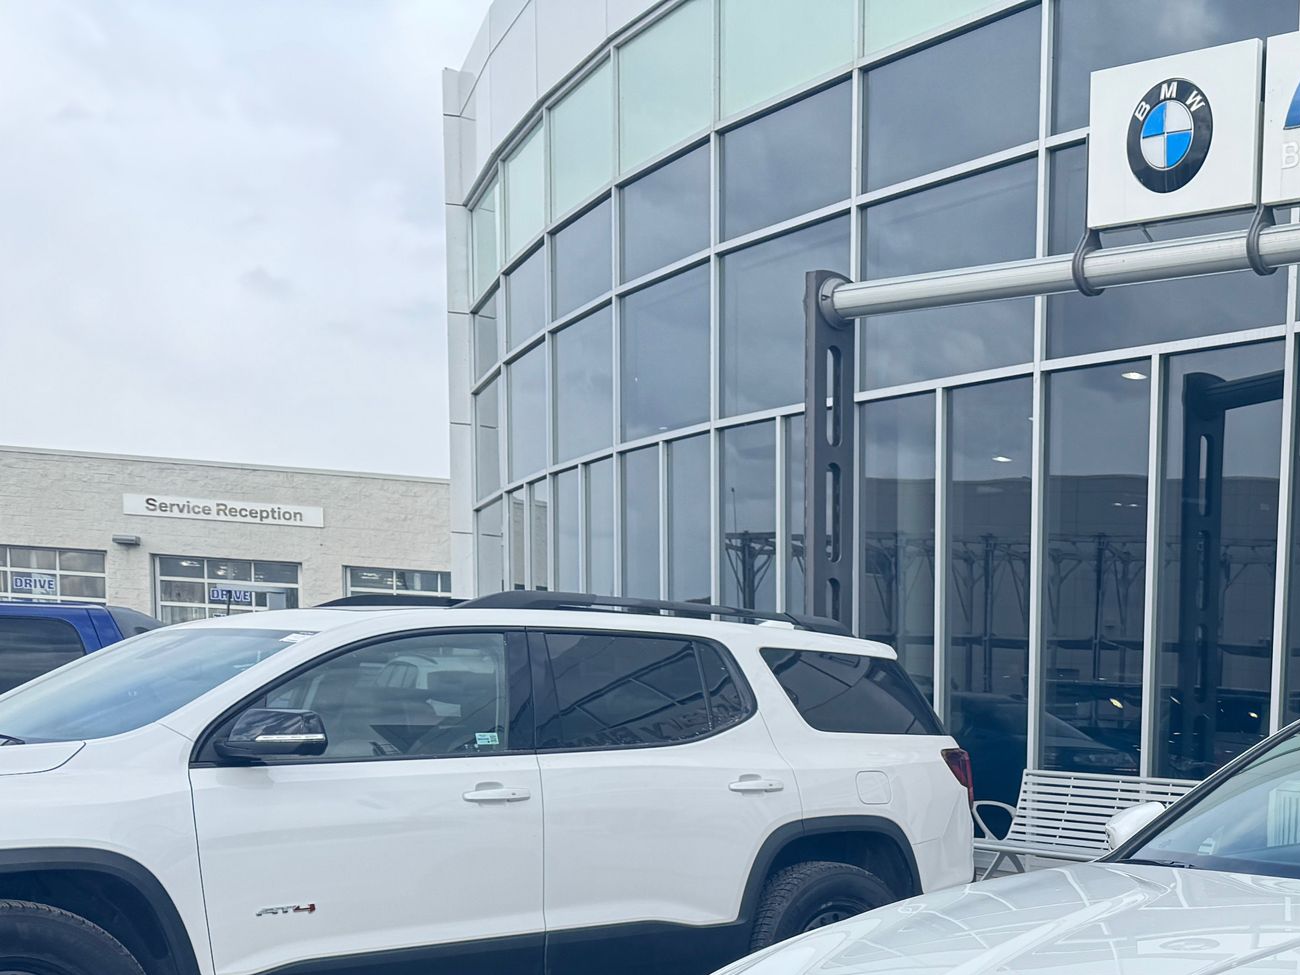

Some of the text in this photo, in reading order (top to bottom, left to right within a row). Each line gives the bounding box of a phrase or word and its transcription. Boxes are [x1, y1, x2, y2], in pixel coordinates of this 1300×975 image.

[1134, 81, 1206, 122] BMW
[145, 497, 303, 522] Service Reception
[13, 576, 56, 590] DRIVE
[256, 903, 315, 916] AT4
